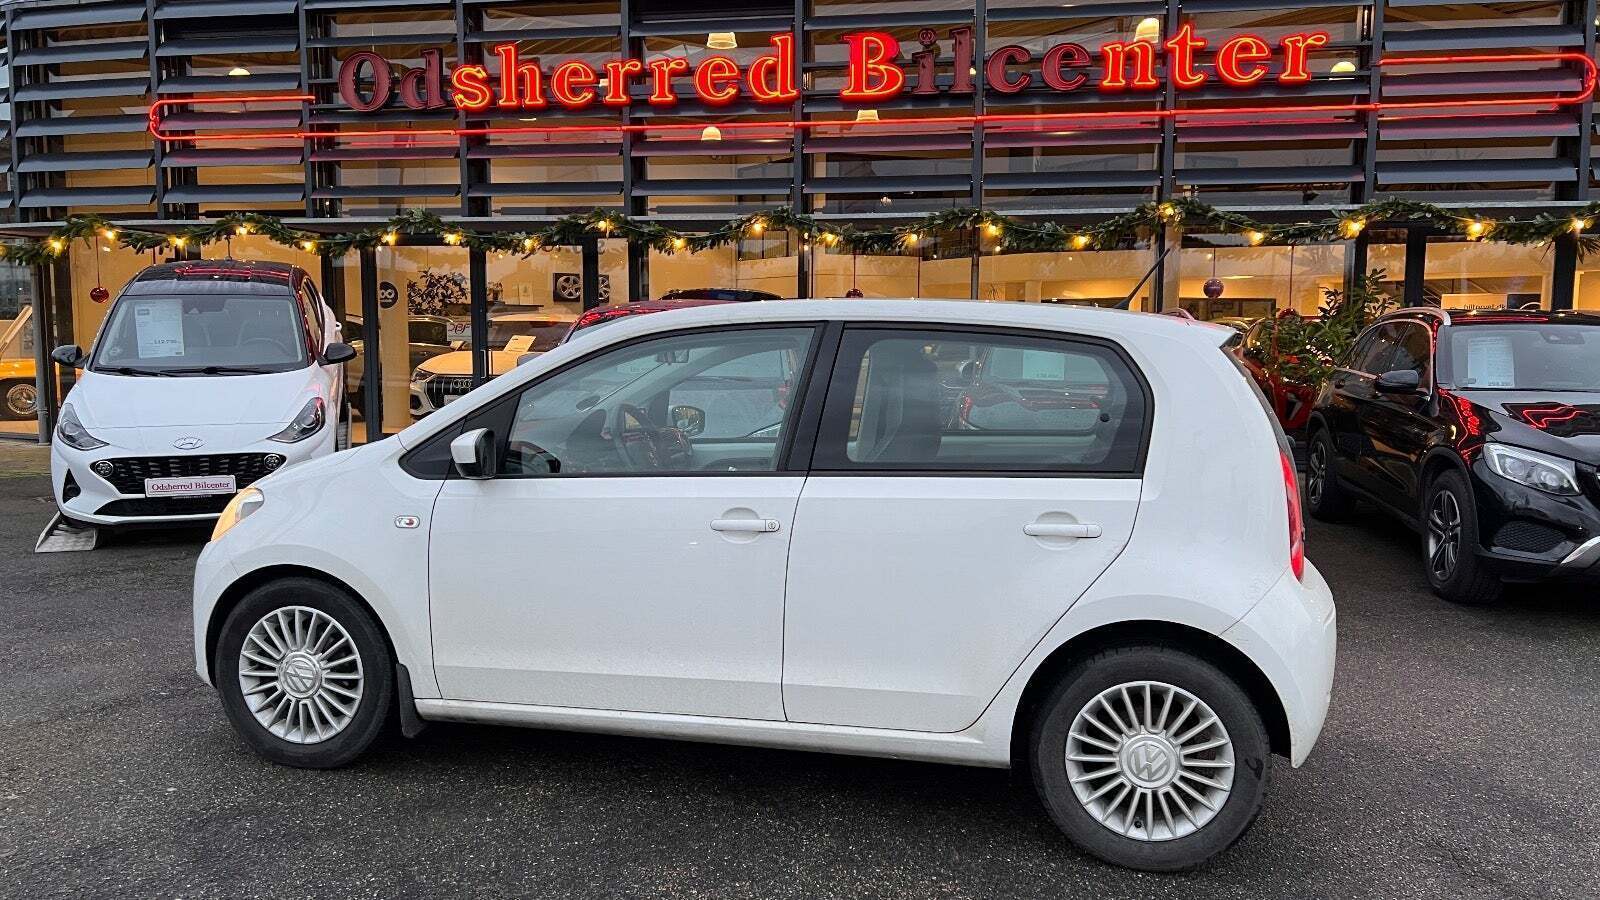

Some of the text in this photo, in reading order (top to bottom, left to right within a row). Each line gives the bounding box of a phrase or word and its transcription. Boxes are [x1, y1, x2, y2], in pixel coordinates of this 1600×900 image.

[338, 22, 1328, 113] Odsherred Bilcenter
[151, 483, 192, 491] Odsherred
